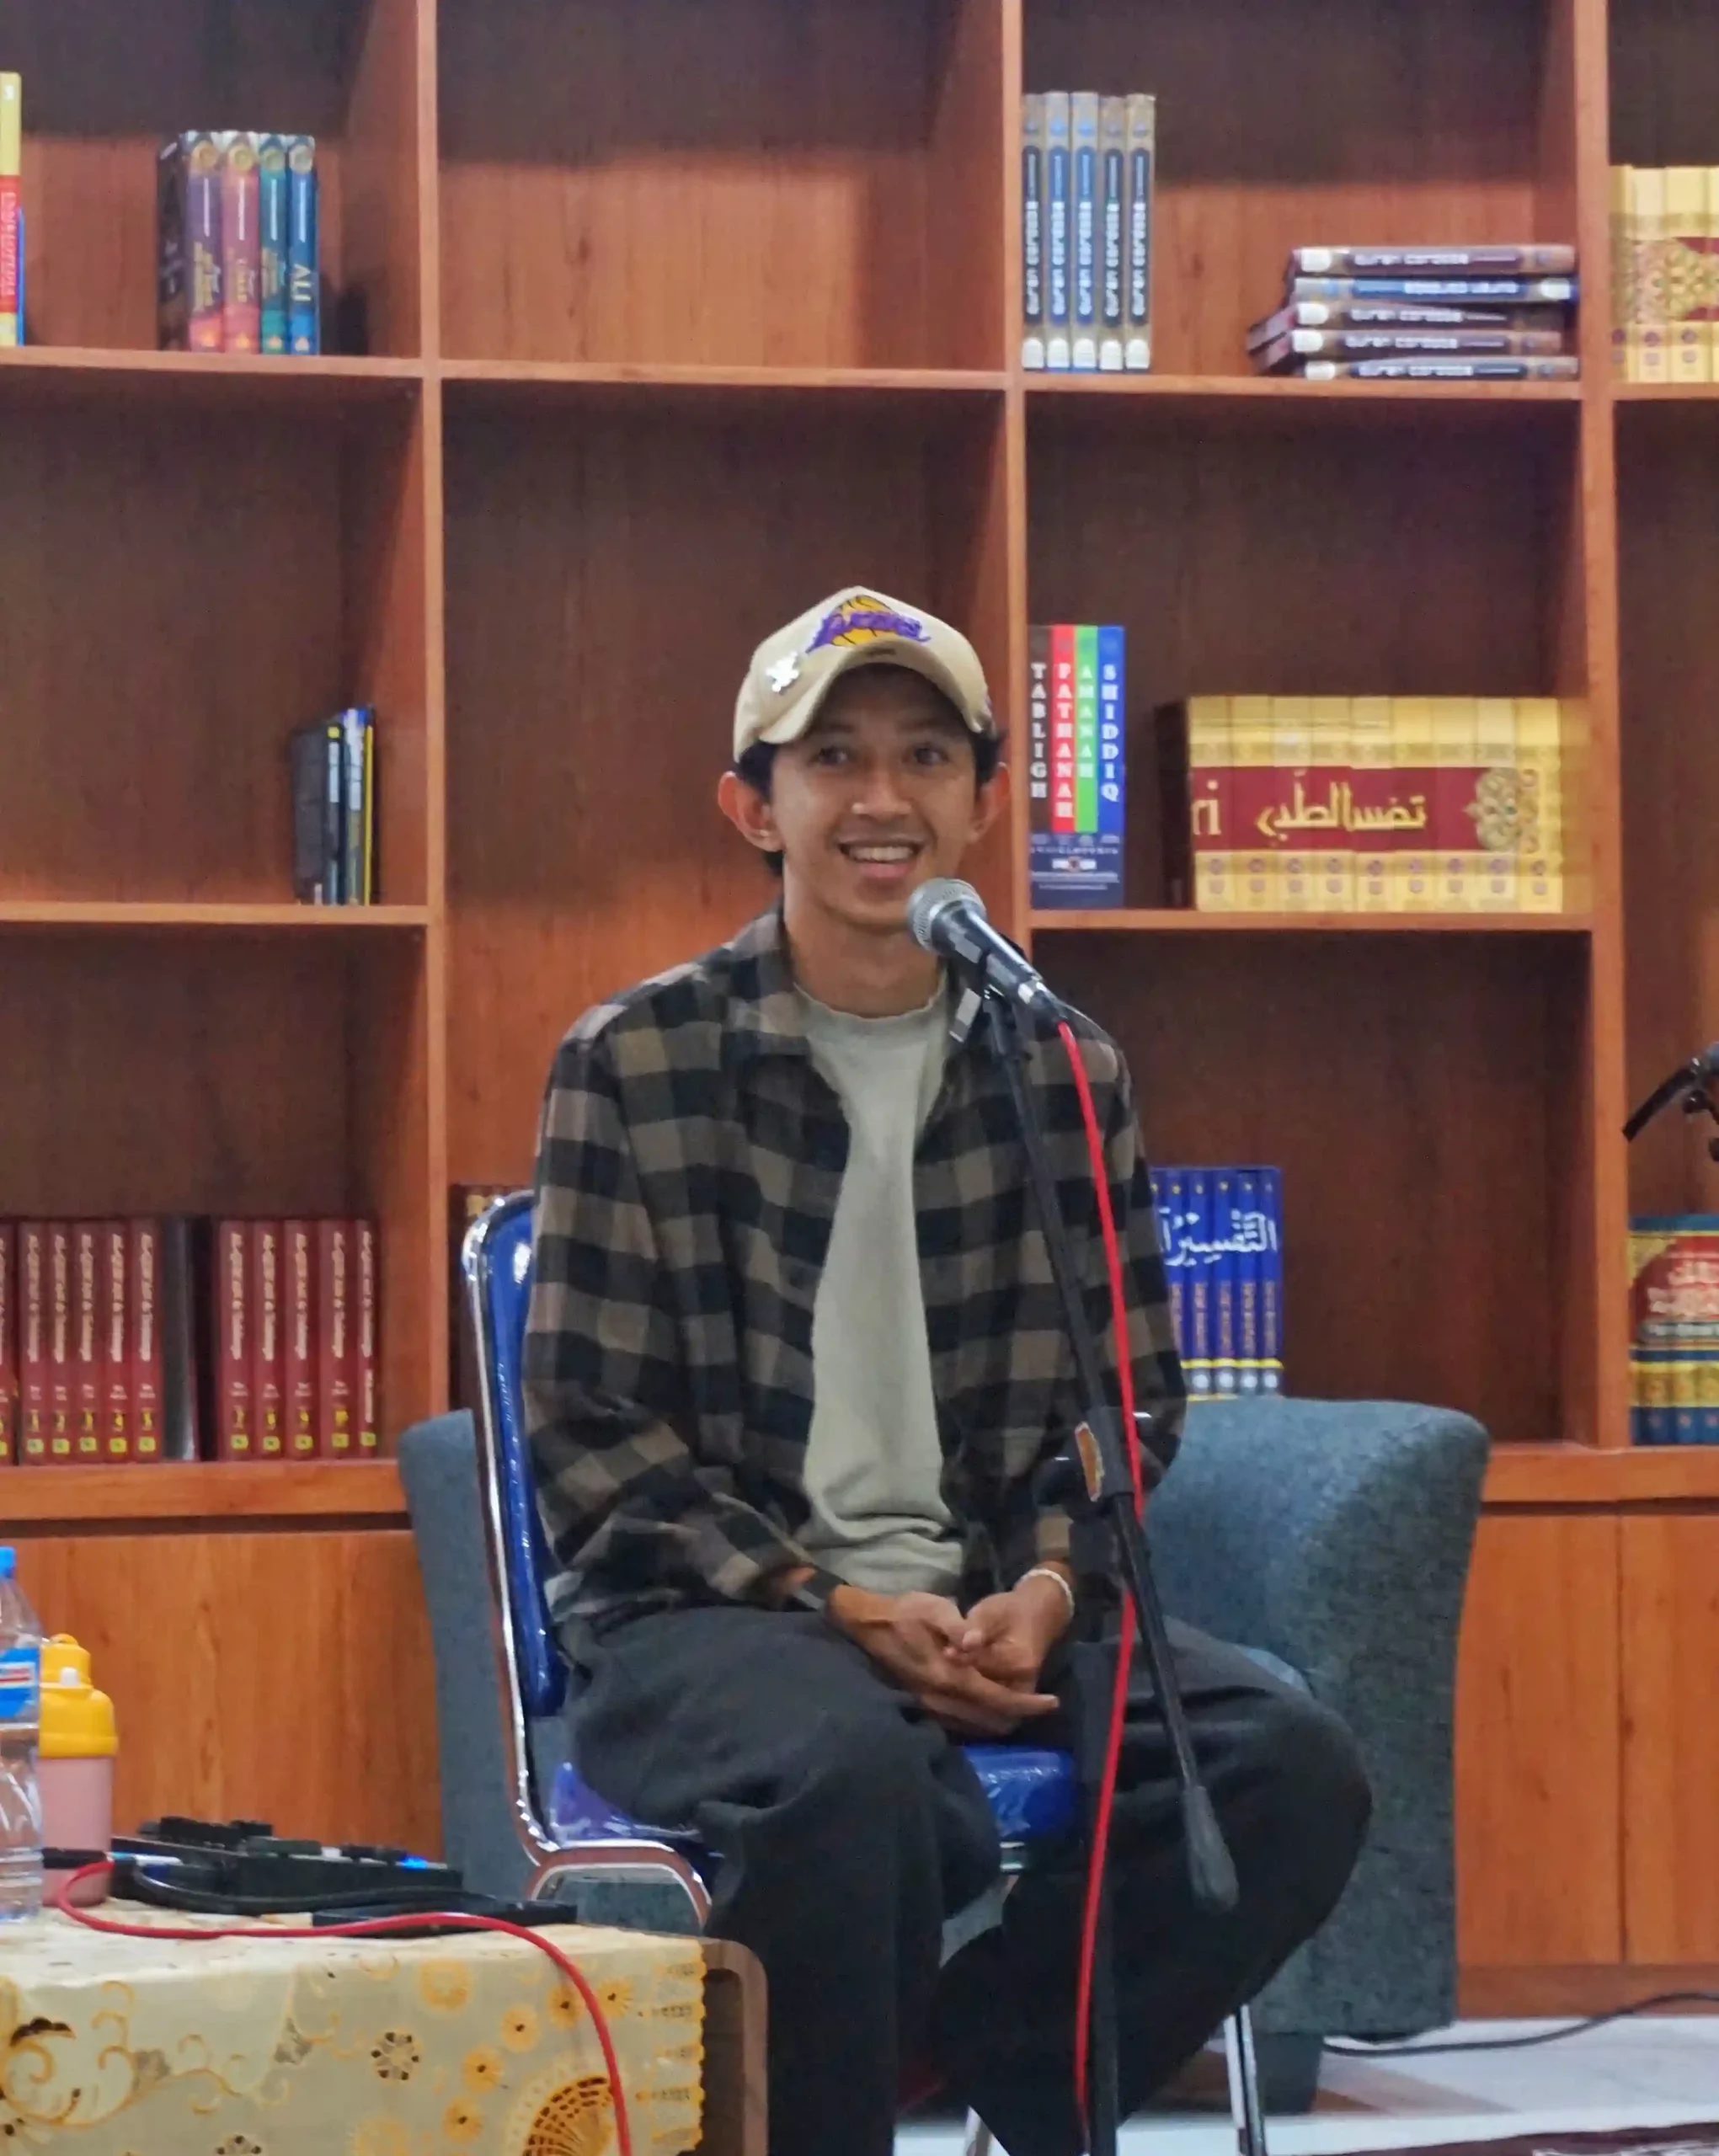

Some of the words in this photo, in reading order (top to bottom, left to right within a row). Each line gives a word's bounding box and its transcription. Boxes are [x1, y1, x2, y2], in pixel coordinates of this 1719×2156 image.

[292, 264, 312, 302] ALI
[1030, 663, 1047, 798] TABLIGH
[1102, 664, 1118, 803] SHIDDIQ
